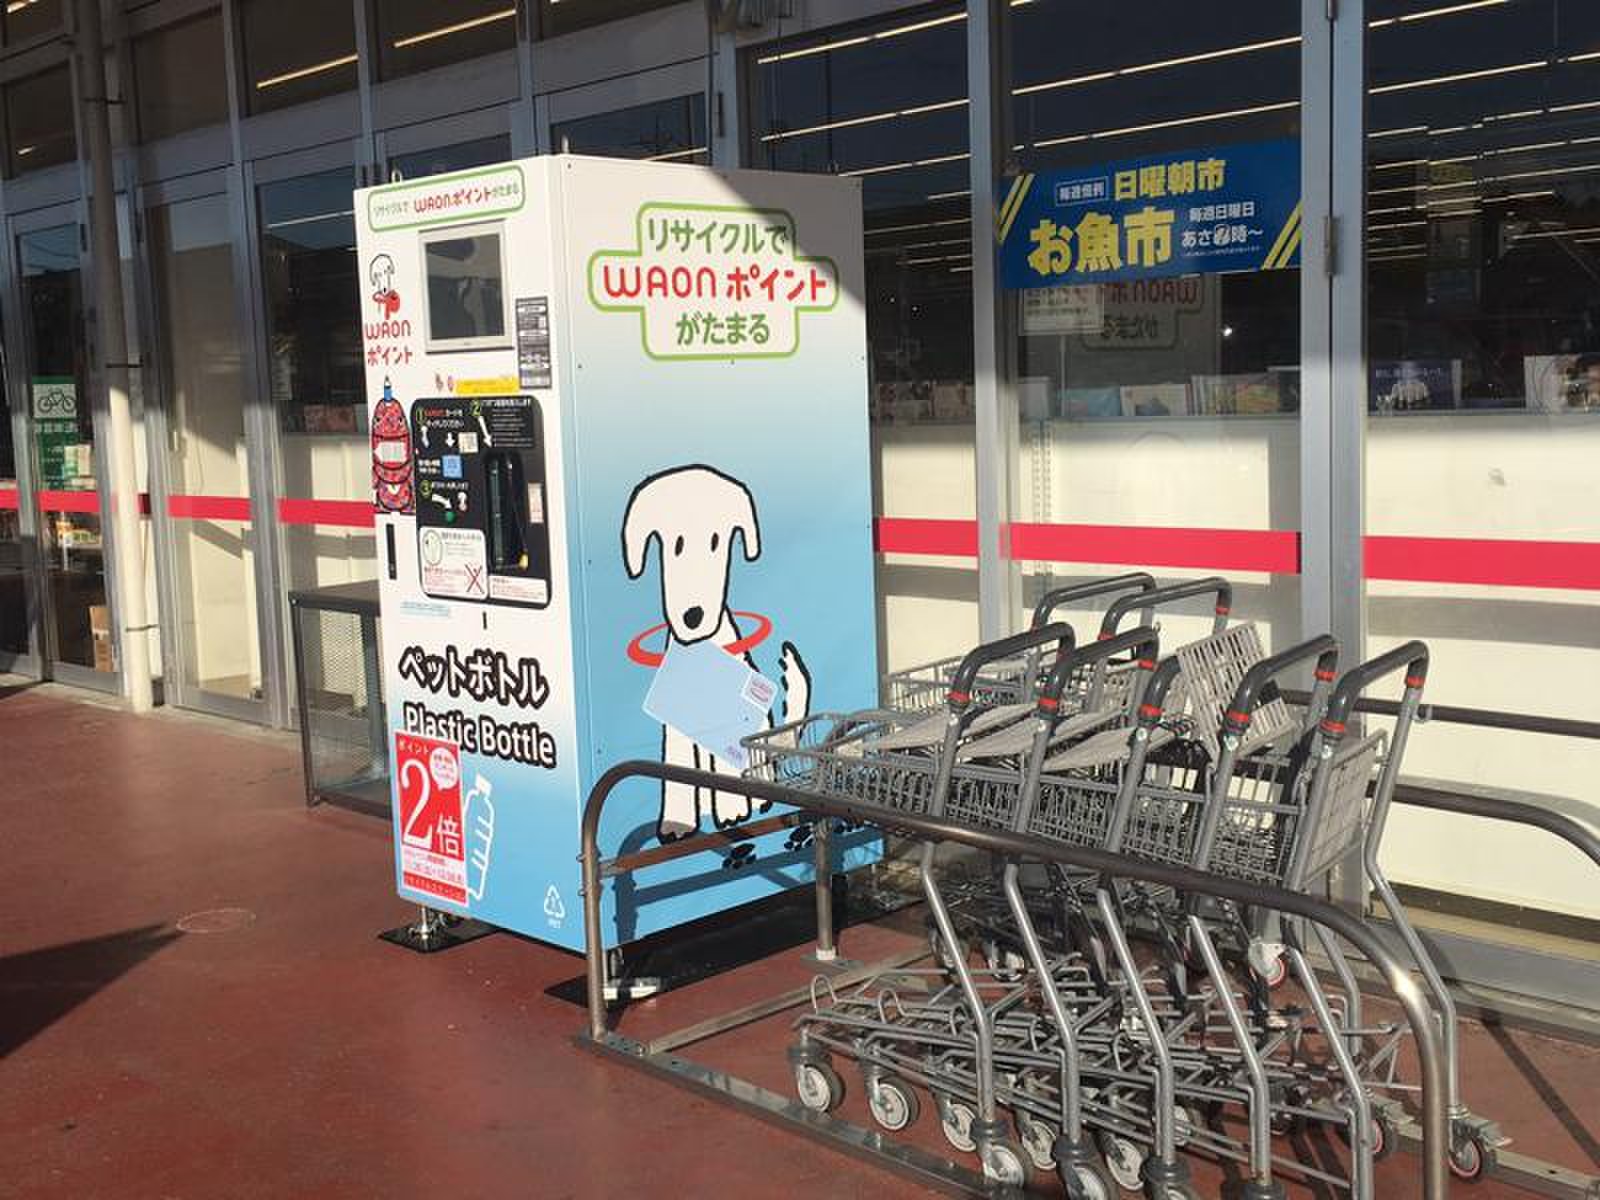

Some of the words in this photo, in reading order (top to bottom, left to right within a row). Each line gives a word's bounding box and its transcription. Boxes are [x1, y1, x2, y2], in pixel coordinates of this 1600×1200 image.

[1114, 158, 1226, 201] 日曜朝市
[1189, 201, 1255, 223] 毎週日曜日
[648, 217, 789, 254] リサイクルで
[1026, 205, 1176, 277] お魚市
[603, 264, 718, 299] WAON
[726, 263, 828, 302] ポイント
[365, 319, 412, 340] WAON
[675, 309, 770, 346] がたまる
[366, 345, 414, 367] ポイント
[400, 644, 550, 709] ペットボトル
[403, 702, 477, 754] Plastic
[479, 707, 557, 769] Bottle
